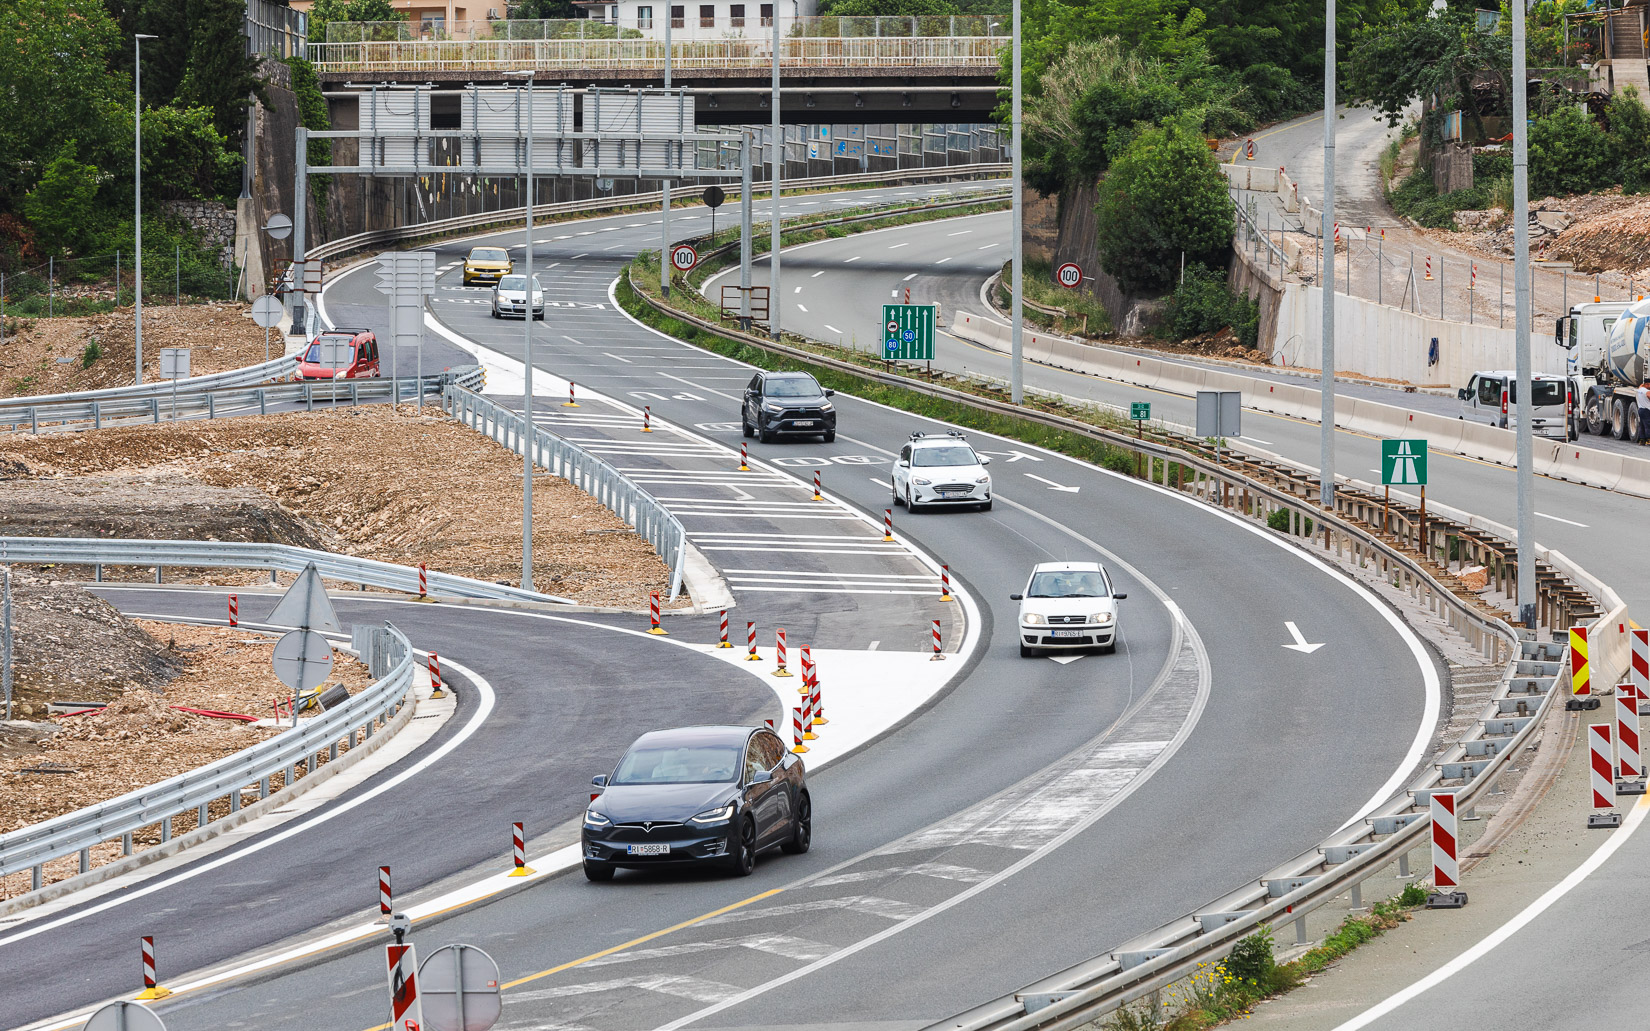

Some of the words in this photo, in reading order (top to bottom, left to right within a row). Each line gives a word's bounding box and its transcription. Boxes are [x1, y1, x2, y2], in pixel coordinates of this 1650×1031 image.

[676, 251, 693, 265] 100
[1062, 270, 1078, 282] 100
[905, 332, 913, 340] 50
[888, 341, 897, 349] 80
